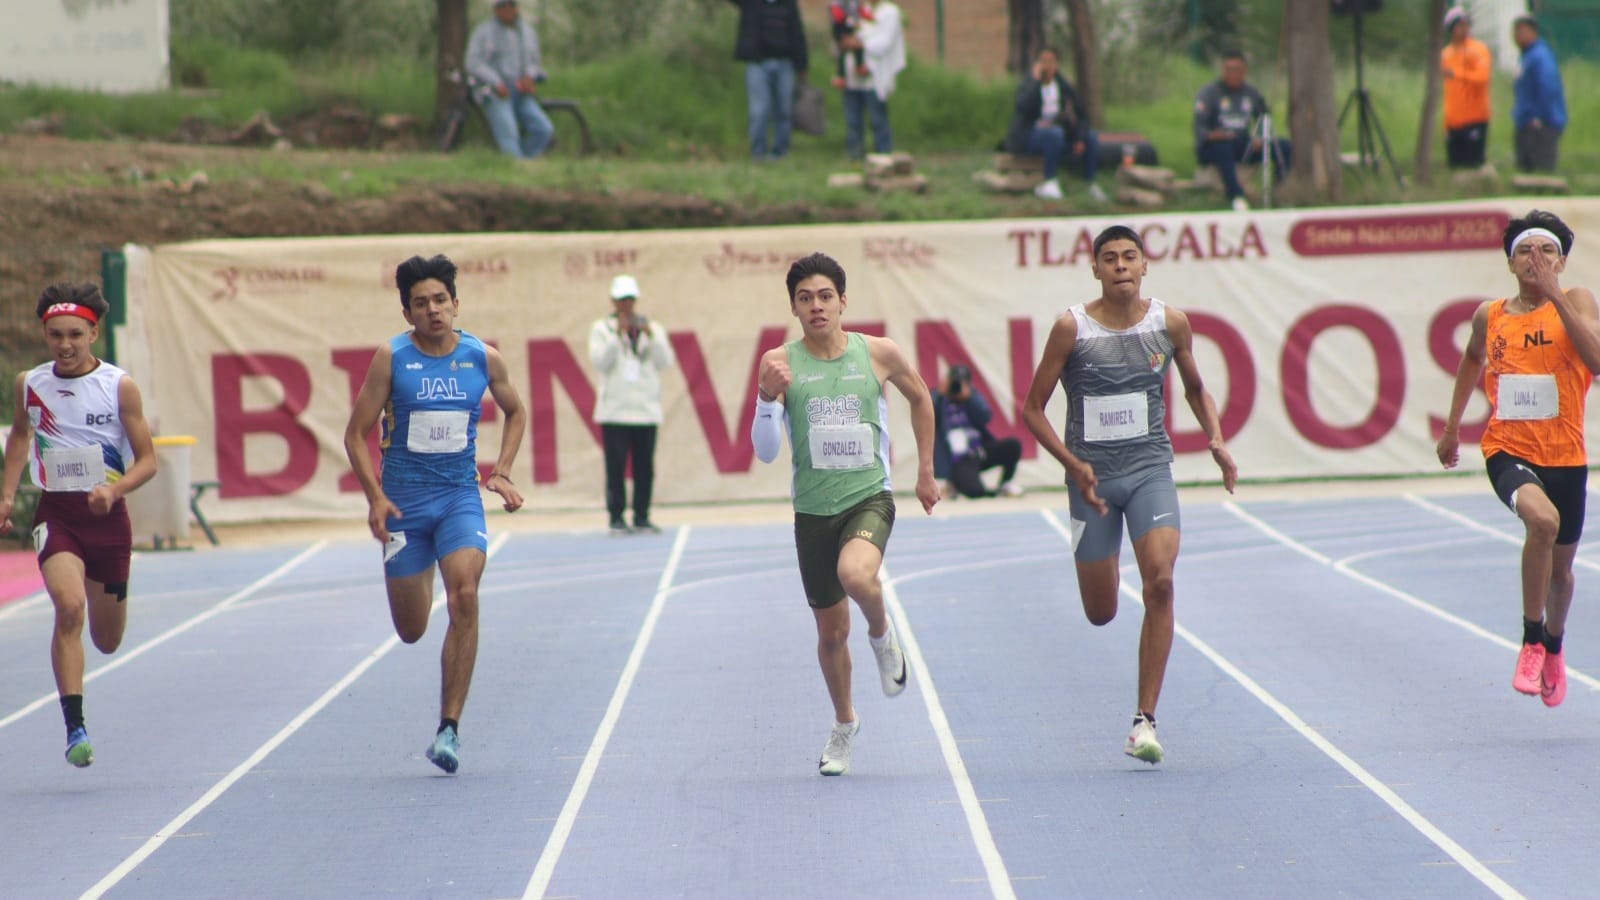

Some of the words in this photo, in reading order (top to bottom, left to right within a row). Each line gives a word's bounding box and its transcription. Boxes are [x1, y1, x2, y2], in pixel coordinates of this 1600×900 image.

[1358, 218, 1447, 246] Nacional
[1451, 216, 1499, 241] 2025
[1007, 221, 1268, 268] TLACALA
[1524, 329, 1553, 349] NL
[416, 377, 467, 400] JAL
[1514, 391, 1531, 406] LUNA
[86, 412, 113, 426] BCS
[1099, 409, 1127, 427] RAMIREZ
[1128, 409, 1135, 424] R.
[430, 425, 445, 441] ALBA
[822, 440, 857, 457] GONZALEZ
[57, 462, 84, 478] RAMIREZ
